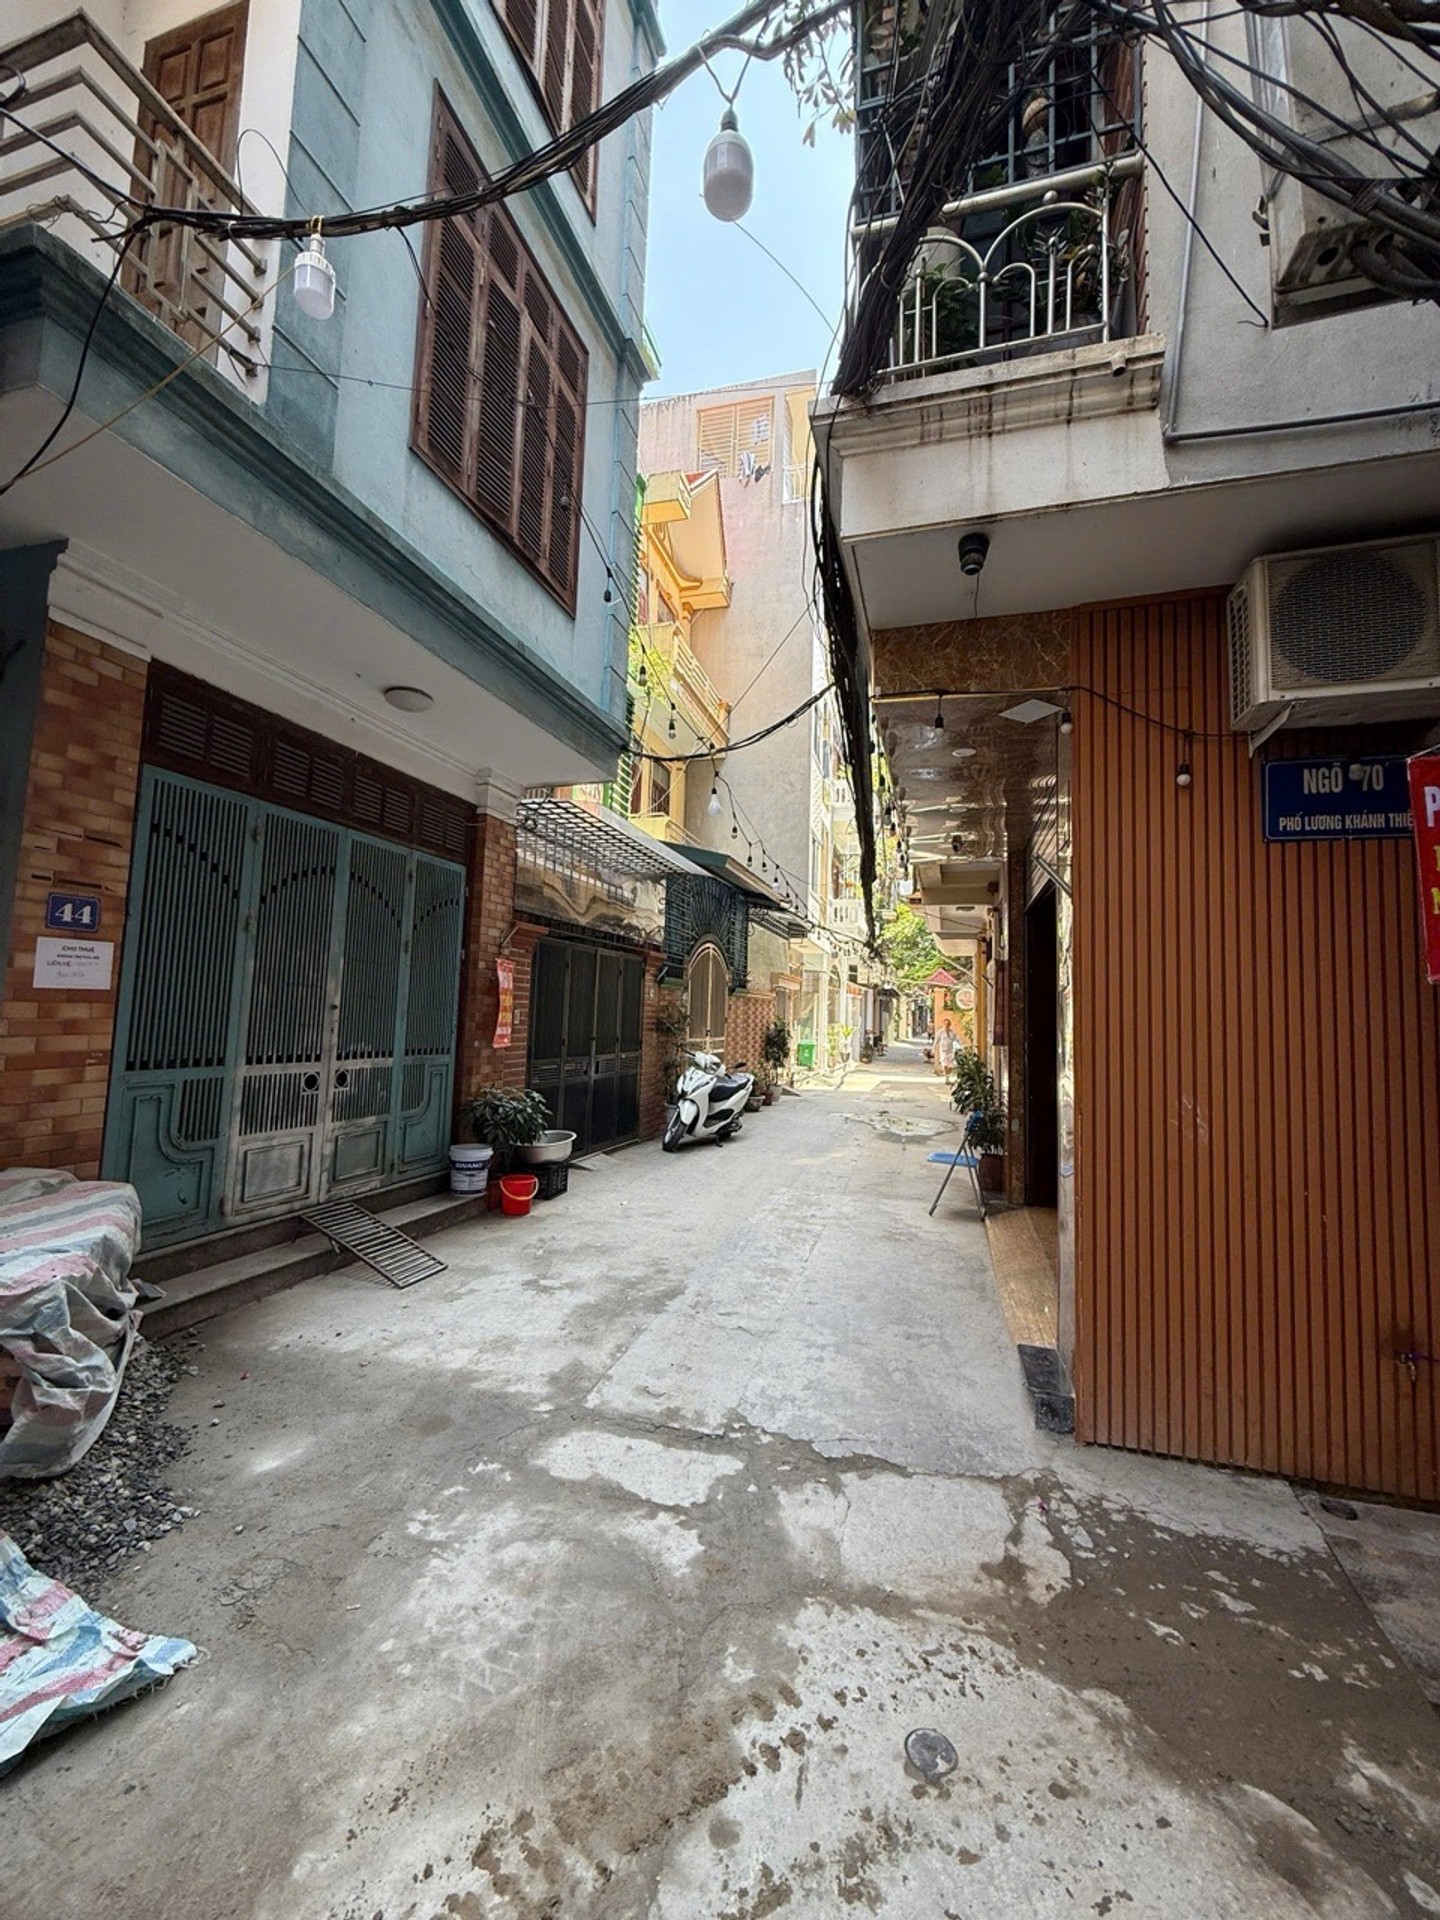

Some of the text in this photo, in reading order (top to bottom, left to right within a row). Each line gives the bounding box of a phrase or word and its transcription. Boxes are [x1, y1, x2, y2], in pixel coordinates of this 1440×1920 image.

[1303, 762, 1384, 795] NGÕ 70
[1279, 809, 1415, 832] PHỐ LƯƠNG KHÁNH THIỆ
[55, 903, 92, 924] 44
